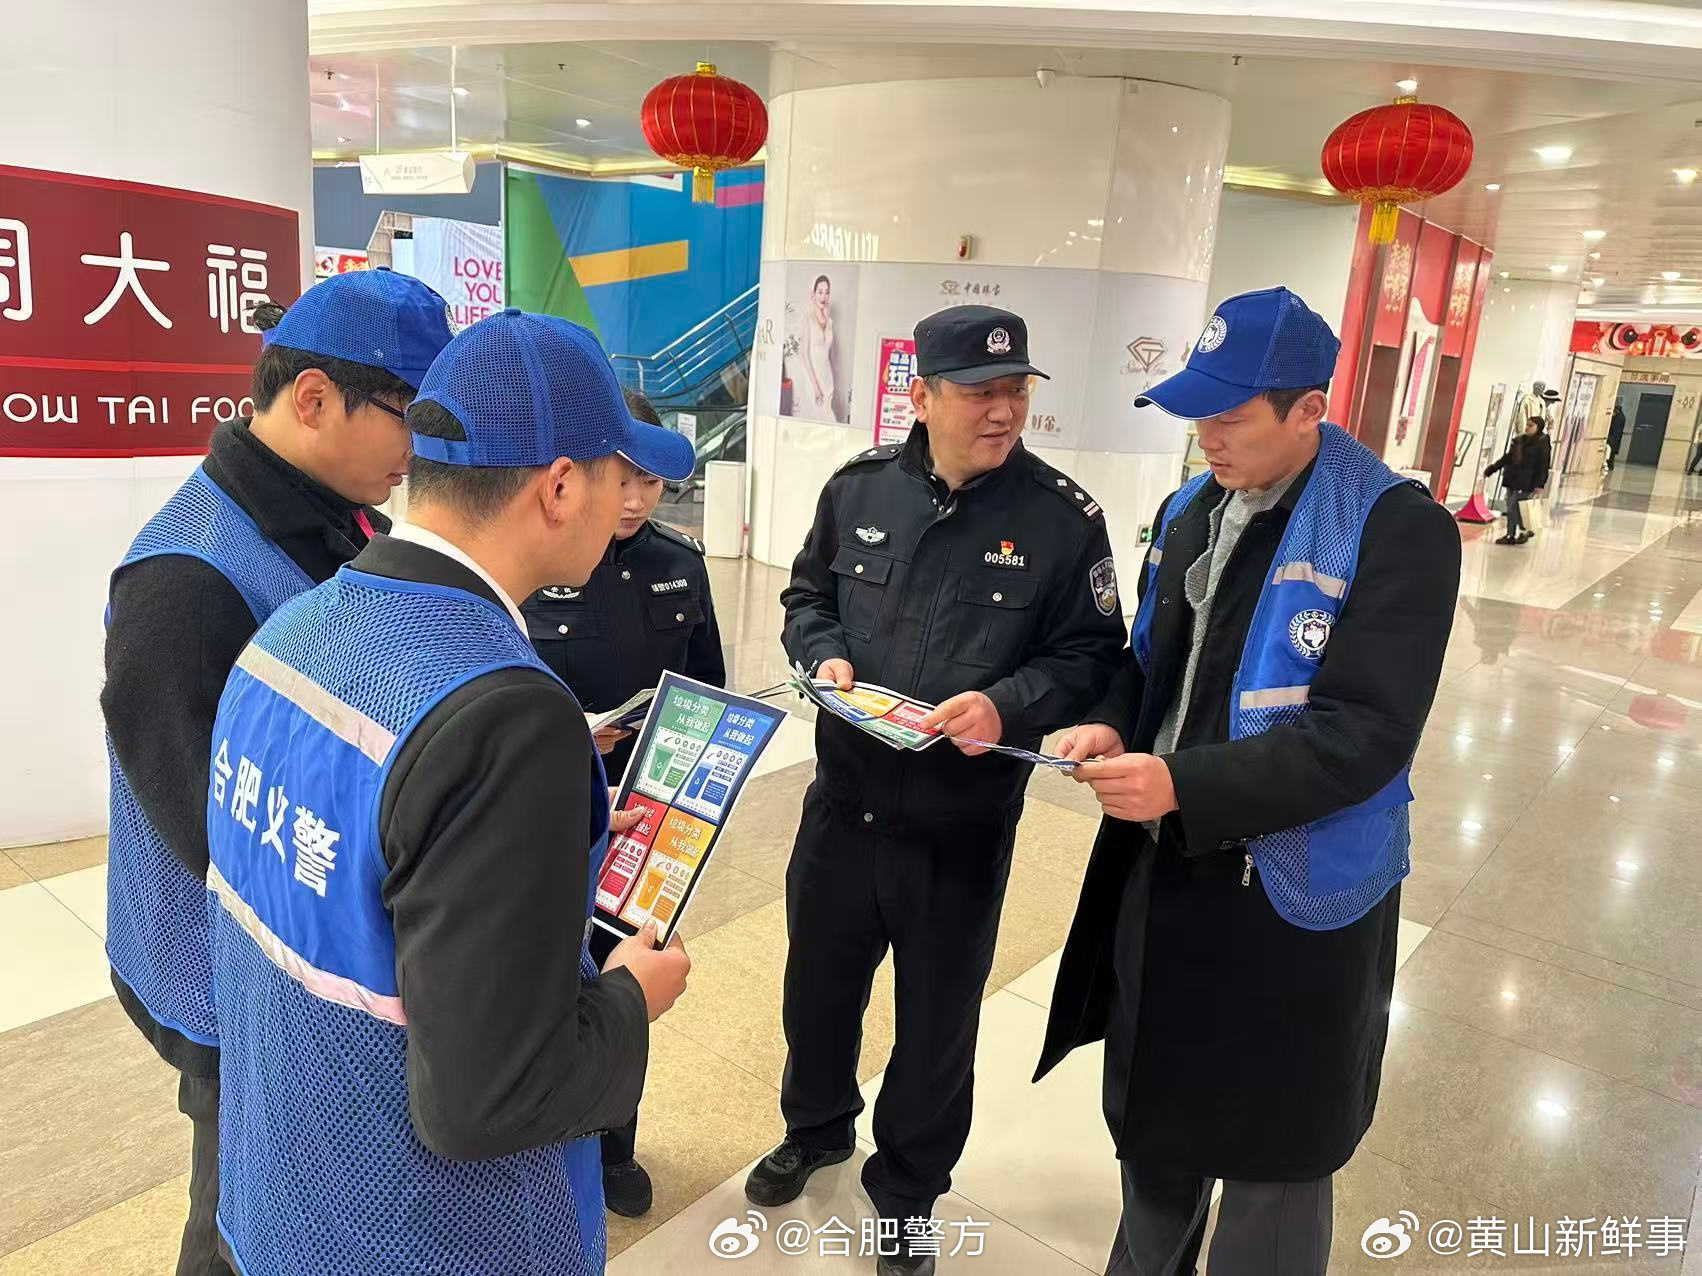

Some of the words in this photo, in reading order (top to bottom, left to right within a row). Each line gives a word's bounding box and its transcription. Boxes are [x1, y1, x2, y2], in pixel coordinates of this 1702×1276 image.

[454, 256, 502, 281] LOVE
[97, 396, 169, 425] TAI
[984, 551, 1026, 567] 005581
[672, 694, 711, 717] 垃圾分类
[675, 713, 712, 733] 从我做起
[726, 712, 756, 730] 垃圾分类
[722, 727, 756, 747] 从我做起
[214, 737, 341, 898] 合肥义警
[669, 817, 702, 840] 垃圾分类
[669, 835, 702, 858] 从我做起
